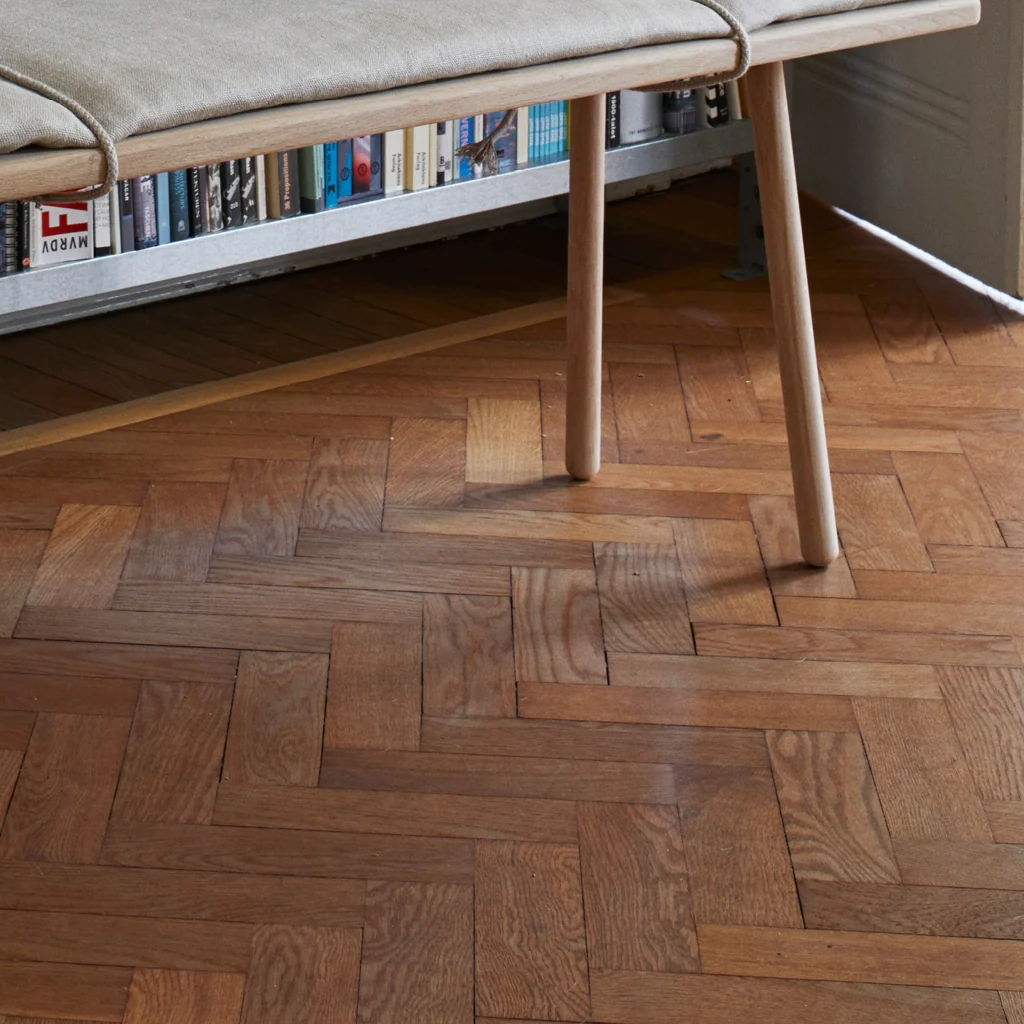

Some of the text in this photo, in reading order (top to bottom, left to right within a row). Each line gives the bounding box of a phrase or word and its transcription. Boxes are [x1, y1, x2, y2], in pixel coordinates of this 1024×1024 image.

[283, 153, 291, 200] Propositions
[143, 205, 151, 238] TASCHEN
[41, 235, 88, 254] MVRDV
